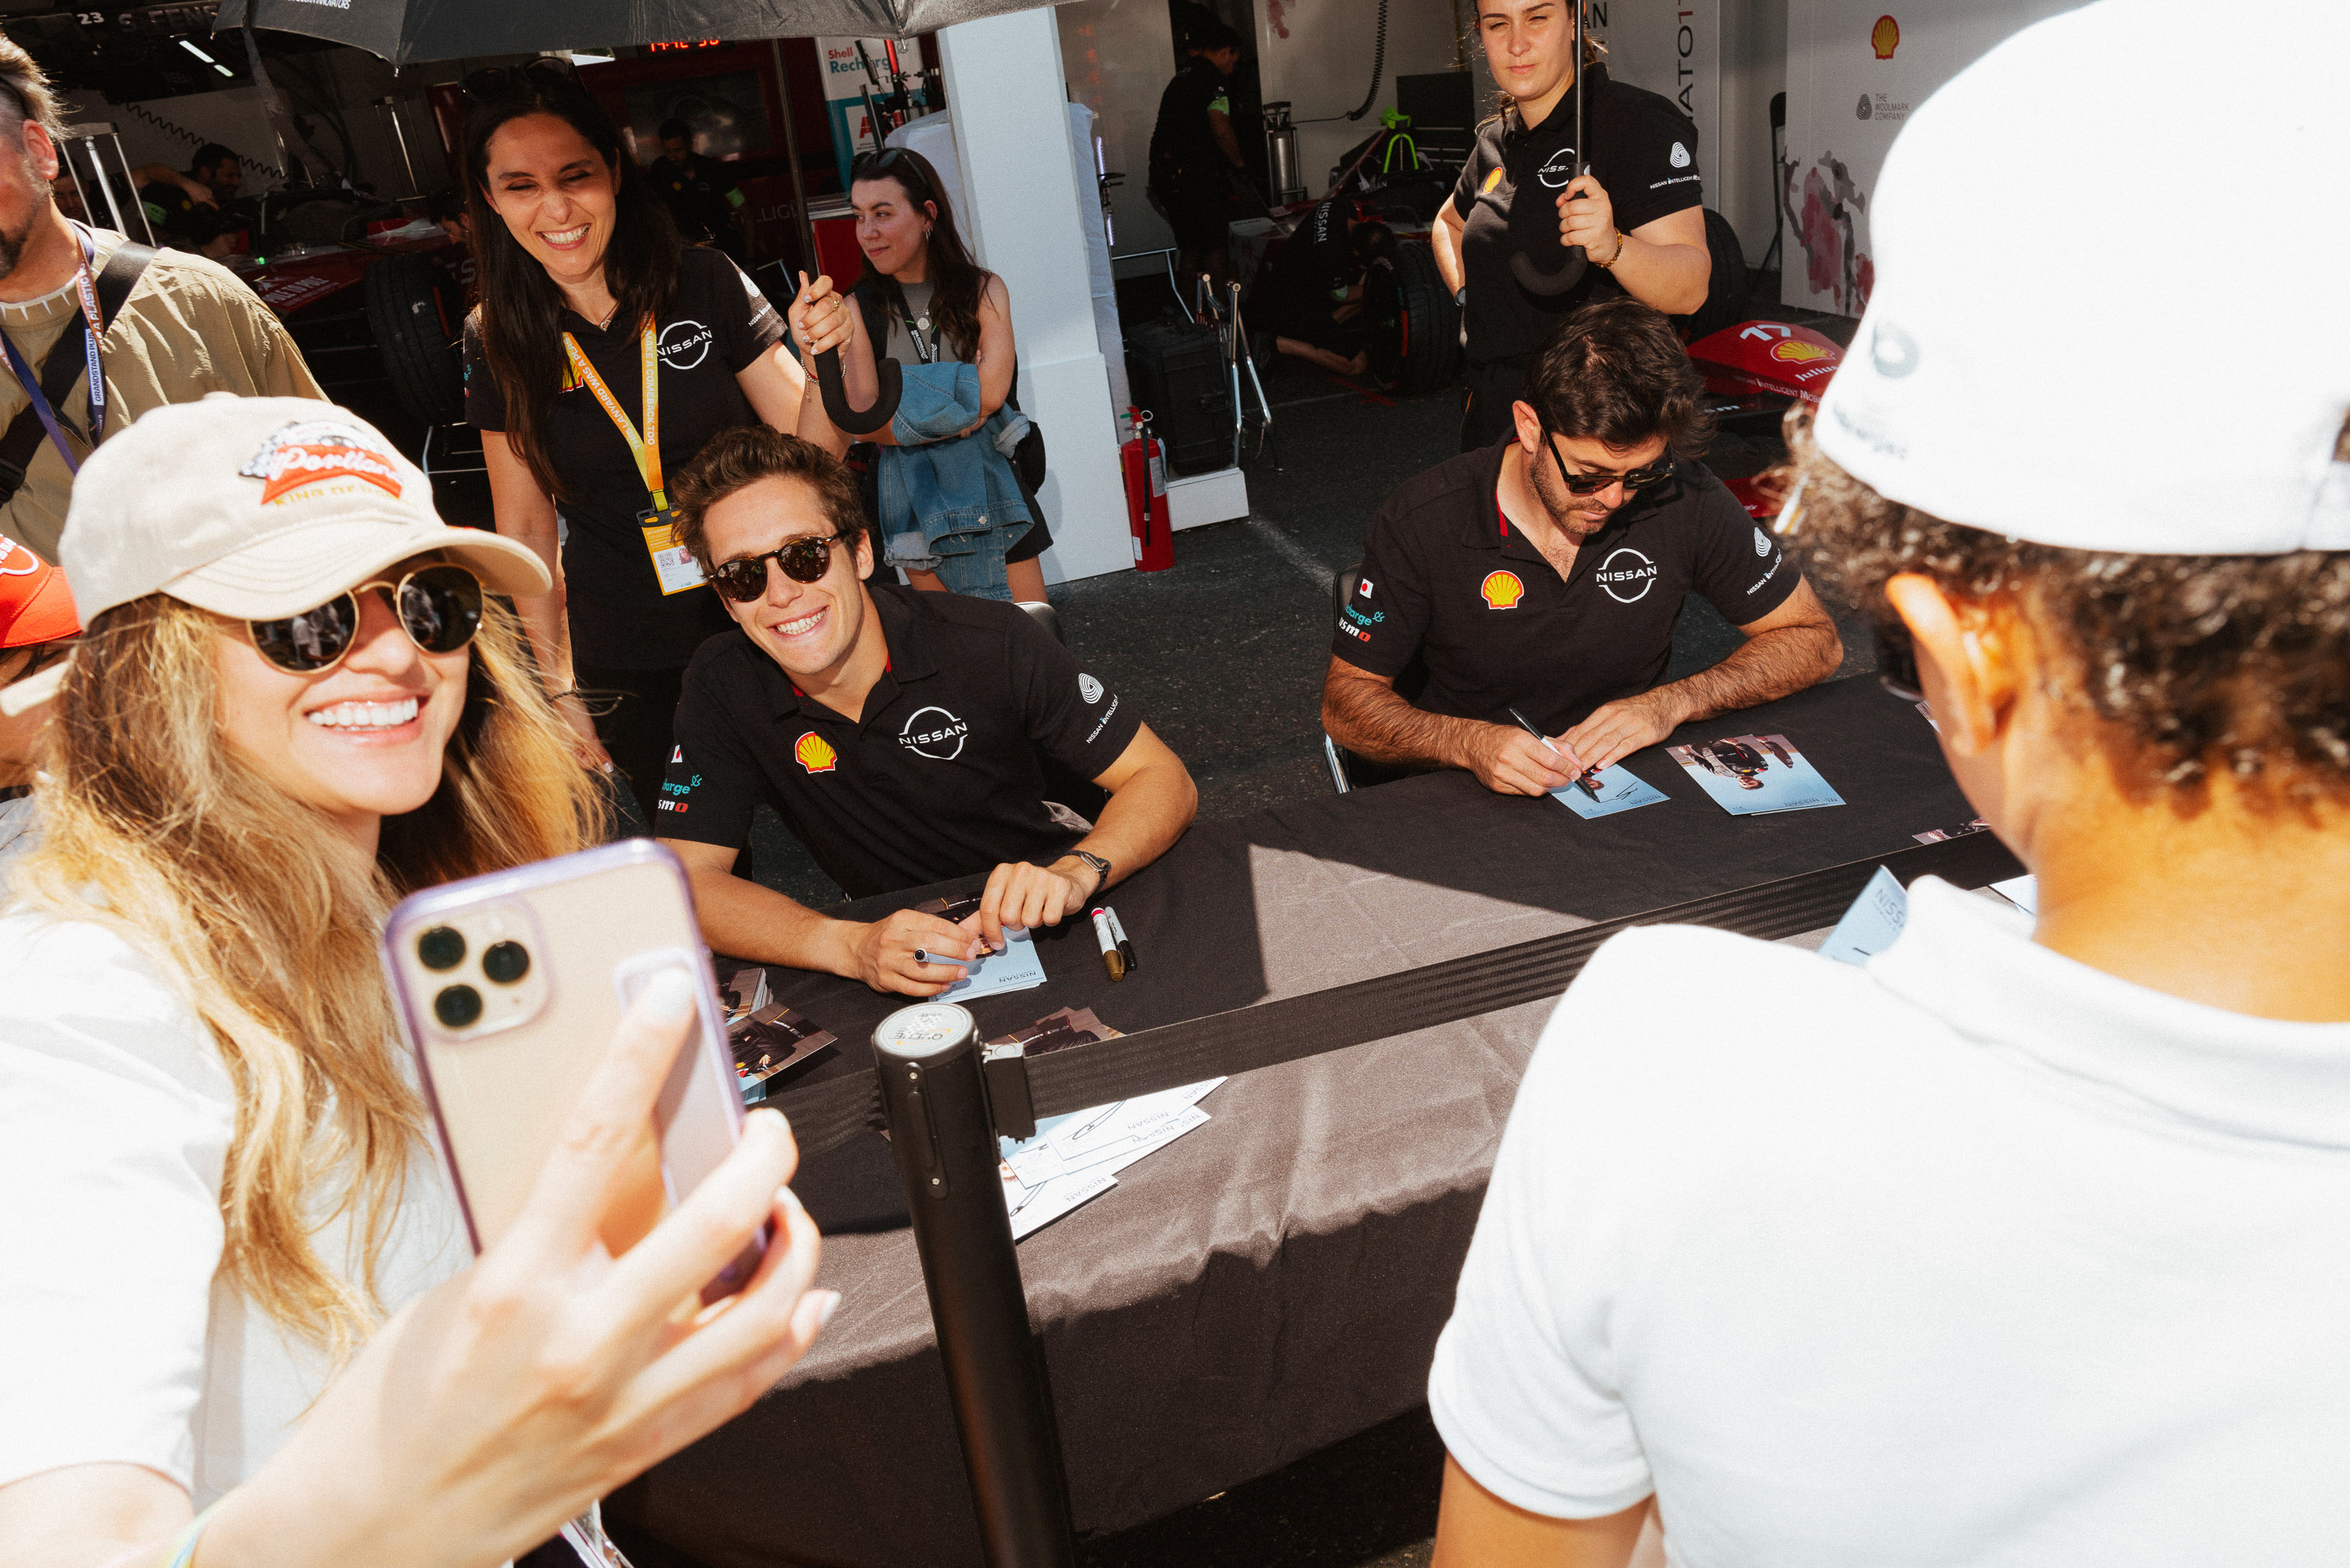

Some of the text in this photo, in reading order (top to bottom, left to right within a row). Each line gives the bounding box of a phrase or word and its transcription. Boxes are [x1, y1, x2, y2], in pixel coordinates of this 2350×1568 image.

[77, 12, 104, 25] 23
[828, 47, 853, 60] Shell
[1875, 93, 1887, 102] THE
[1875, 103, 1910, 111] WOOLMARK
[1875, 112, 1905, 121] COMPANY
[1650, 180, 1668, 190] NISSAN
[1318, 202, 1332, 242] NISSAN
[79, 276, 99, 321] PLASTIC
[1740, 324, 1791, 341] 17
[645, 330, 653, 359] MAKE
[656, 330, 713, 357] NISSAN
[89, 352, 102, 402] GRANDSTAND
[582, 367, 601, 388] WAS
[1757, 378, 1799, 396] INTELLIGENT
[645, 369, 655, 424] COMEBACK
[597, 388, 630, 428] LANYARD
[625, 428, 642, 450] THIS
[646, 425, 656, 446] TOO
[1596, 565, 1658, 583] NISSAN
[1746, 577, 1767, 595] NISSAN
[898, 721, 968, 745] NISSAN
[1086, 723, 1104, 744] NISSAN
[658, 799, 689, 813] smo
[1874, 888, 1904, 928] NISS
[999, 971, 1036, 983] NISSAN
[1127, 1111, 1170, 1130] NISSAN
[1065, 1176, 1107, 1202] NISSAN
